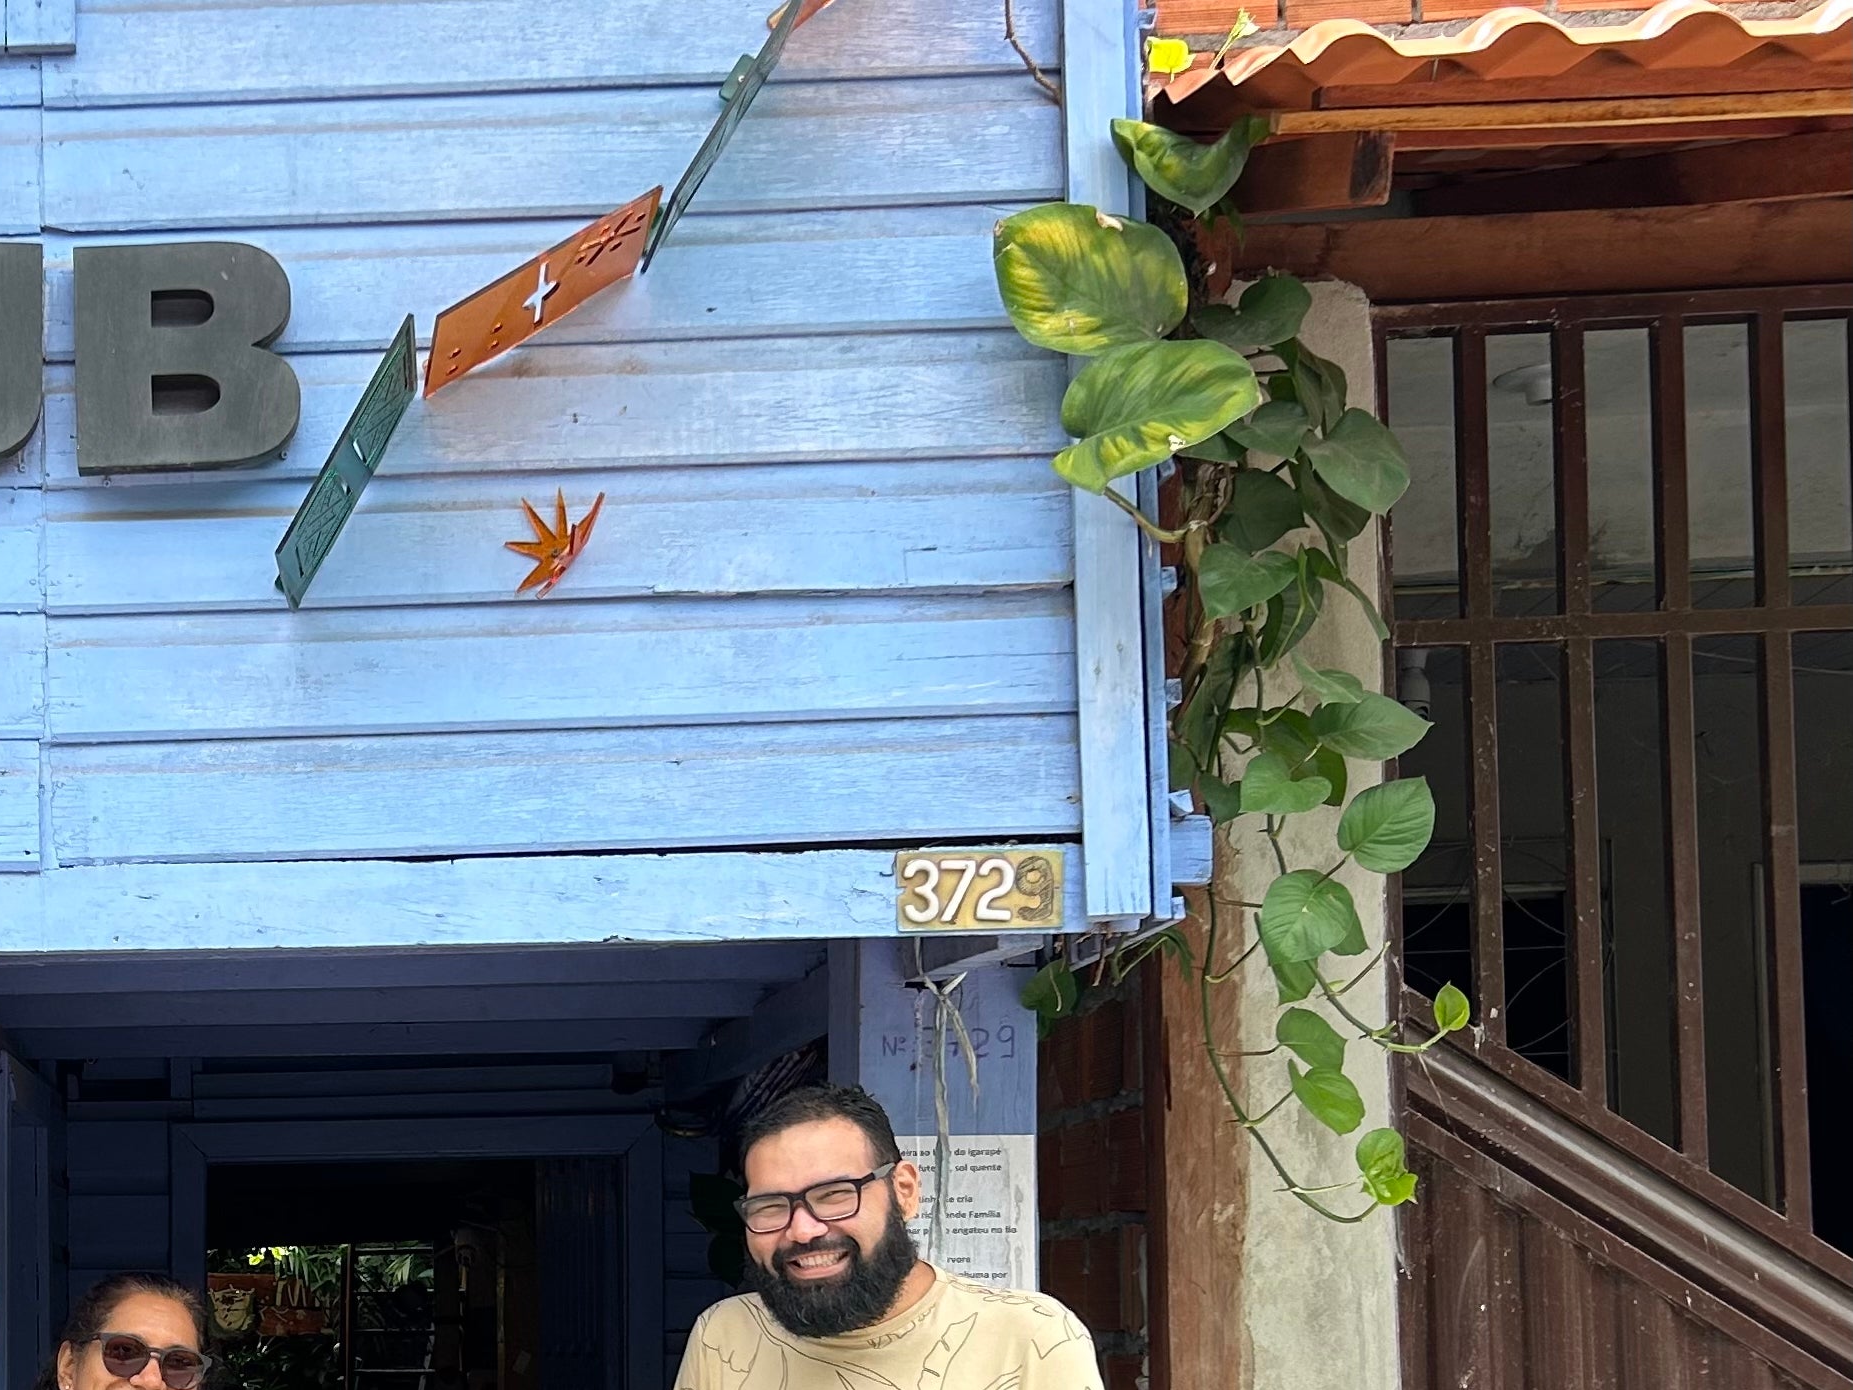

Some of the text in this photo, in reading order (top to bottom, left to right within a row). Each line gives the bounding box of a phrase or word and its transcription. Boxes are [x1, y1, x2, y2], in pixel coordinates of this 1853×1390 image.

[903, 855, 1055, 924] 3729
[954, 1164, 968, 1172] sol
[970, 1164, 1002, 1173] quente
